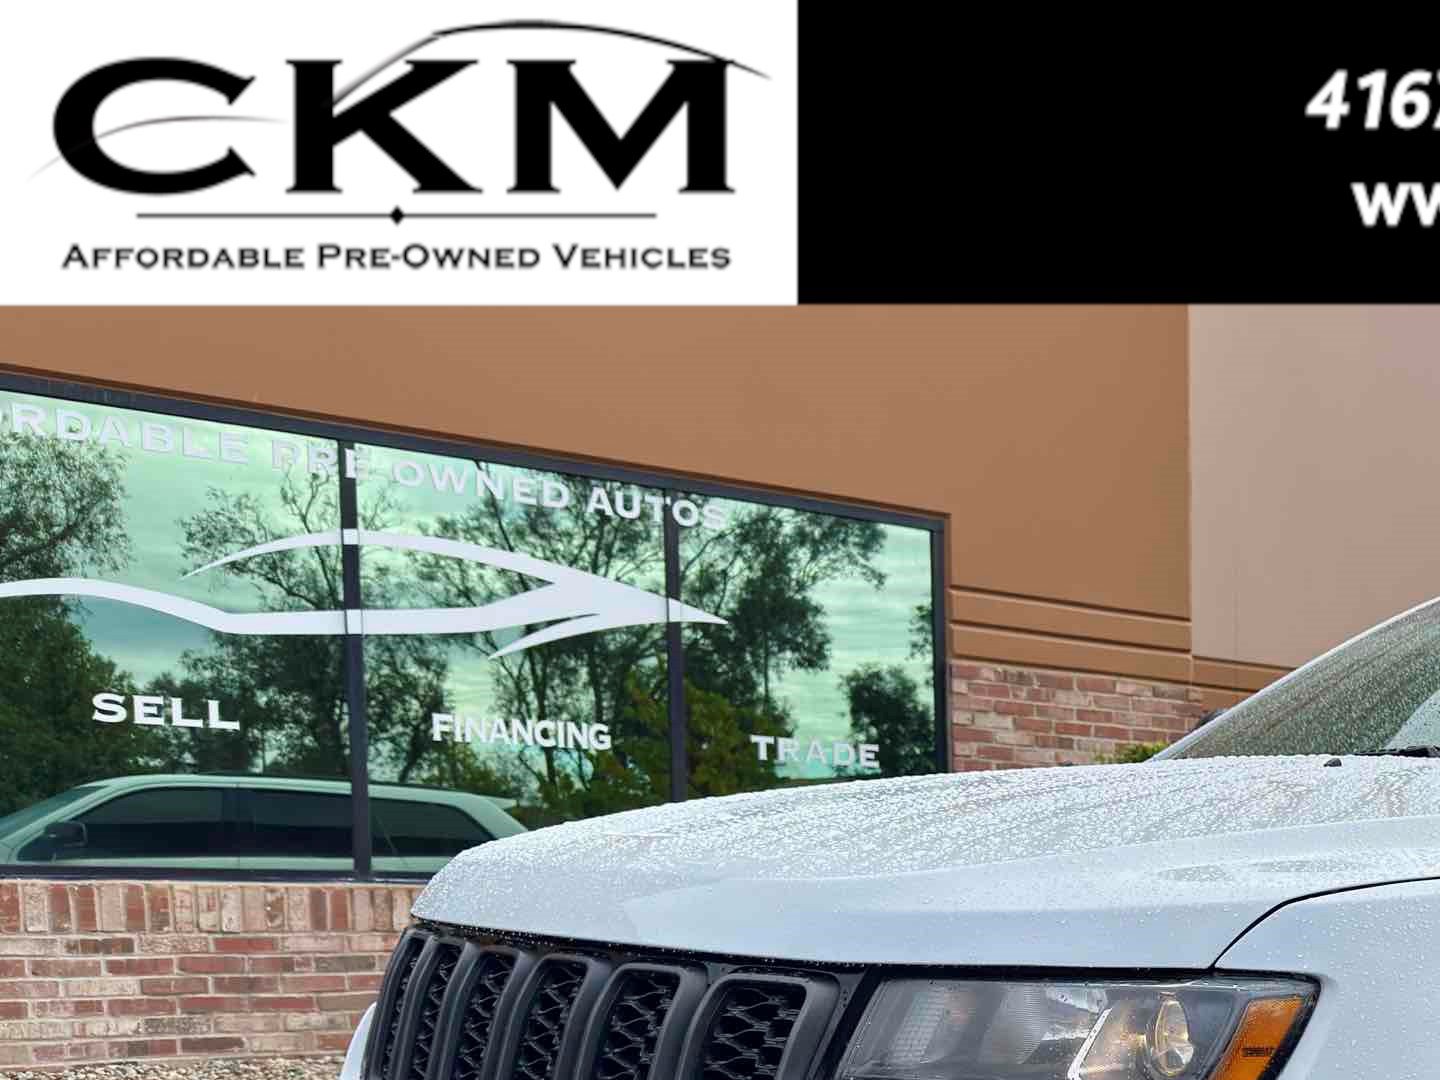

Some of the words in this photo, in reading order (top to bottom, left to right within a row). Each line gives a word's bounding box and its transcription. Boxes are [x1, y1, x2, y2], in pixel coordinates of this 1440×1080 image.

[0, 400, 249, 465] RDABLE
[391, 459, 570, 510] OWNED
[585, 483, 727, 532] AUTOS
[91, 692, 240, 731] SELL
[431, 712, 612, 751] FINANCING
[750, 734, 880, 769] TRADE
